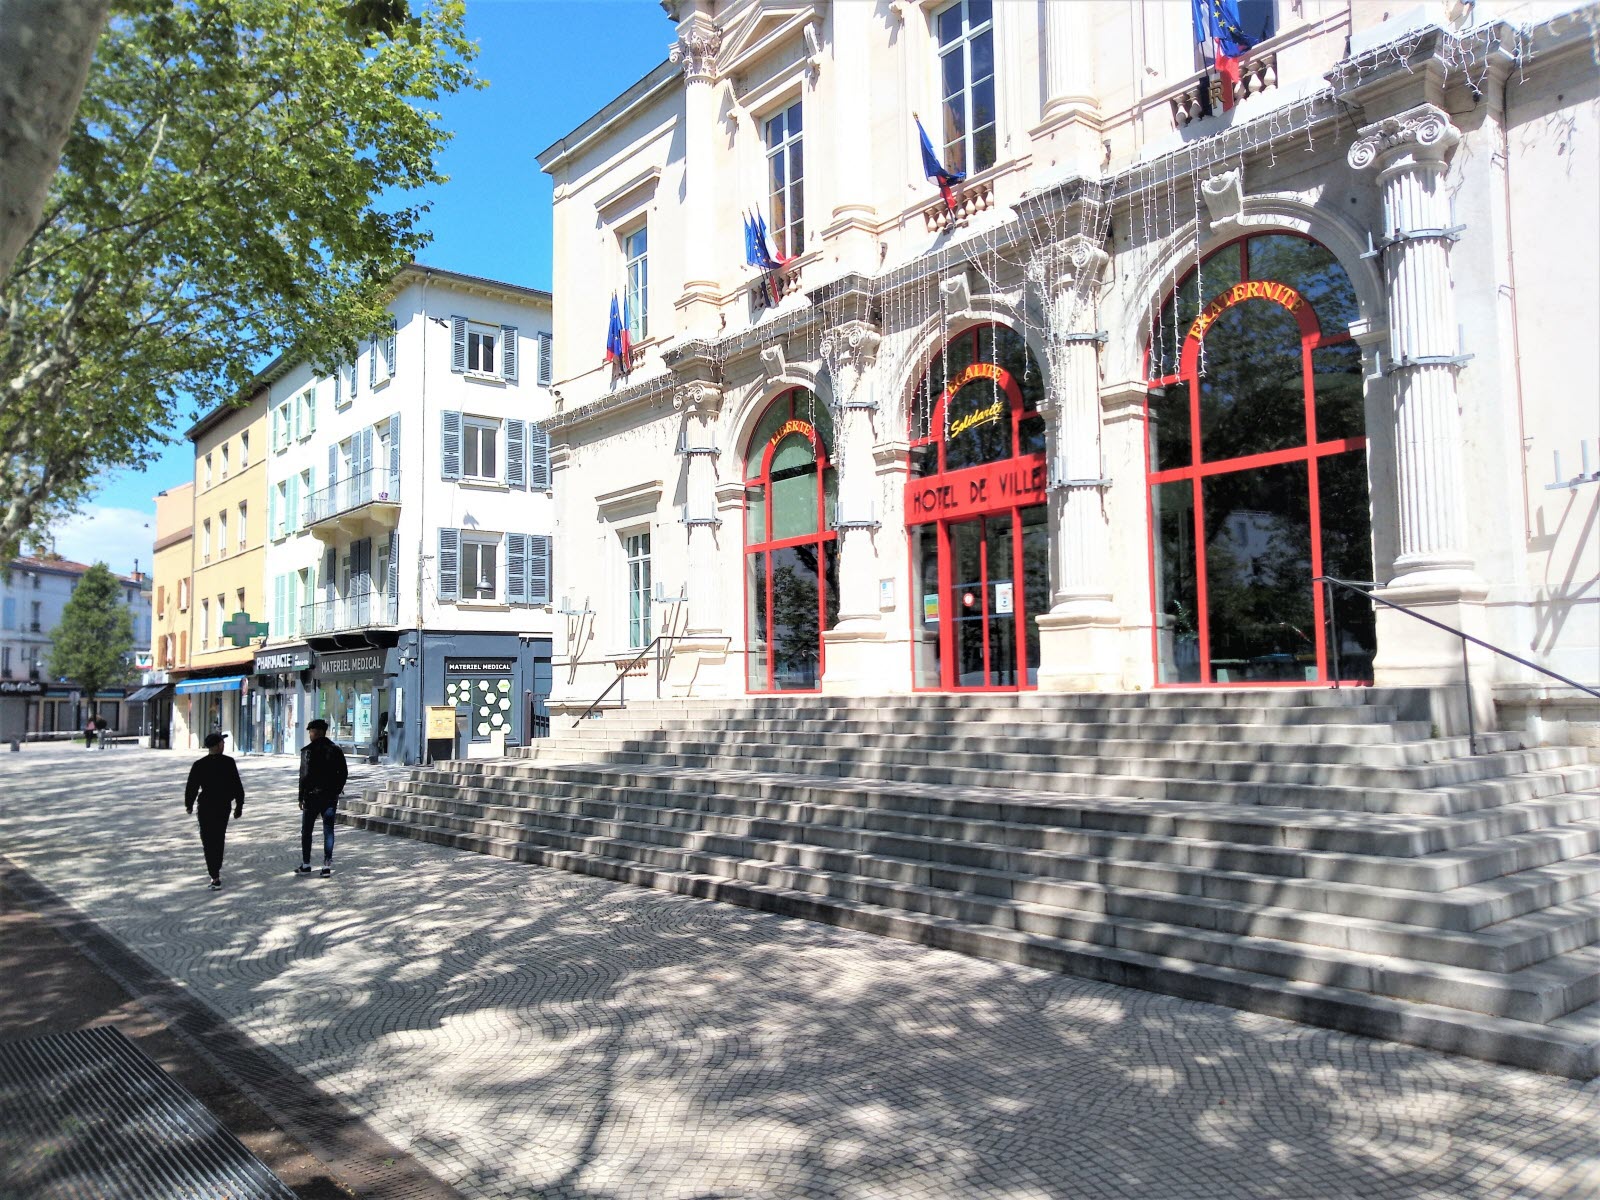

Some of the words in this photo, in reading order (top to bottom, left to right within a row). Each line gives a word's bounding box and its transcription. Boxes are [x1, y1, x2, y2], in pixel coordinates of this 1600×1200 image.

[1189, 281, 1305, 341] FRATERNITE
[947, 363, 1004, 395] EGALITE
[770, 420, 812, 447] LIBERTE
[914, 485, 958, 515] HOTEL
[970, 478, 987, 504] DE
[999, 466, 1042, 496] VILLE
[256, 653, 291, 670] PHARMACIE
[321, 659, 350, 674] MATERIEL
[351, 656, 381, 670] MEDICAL
